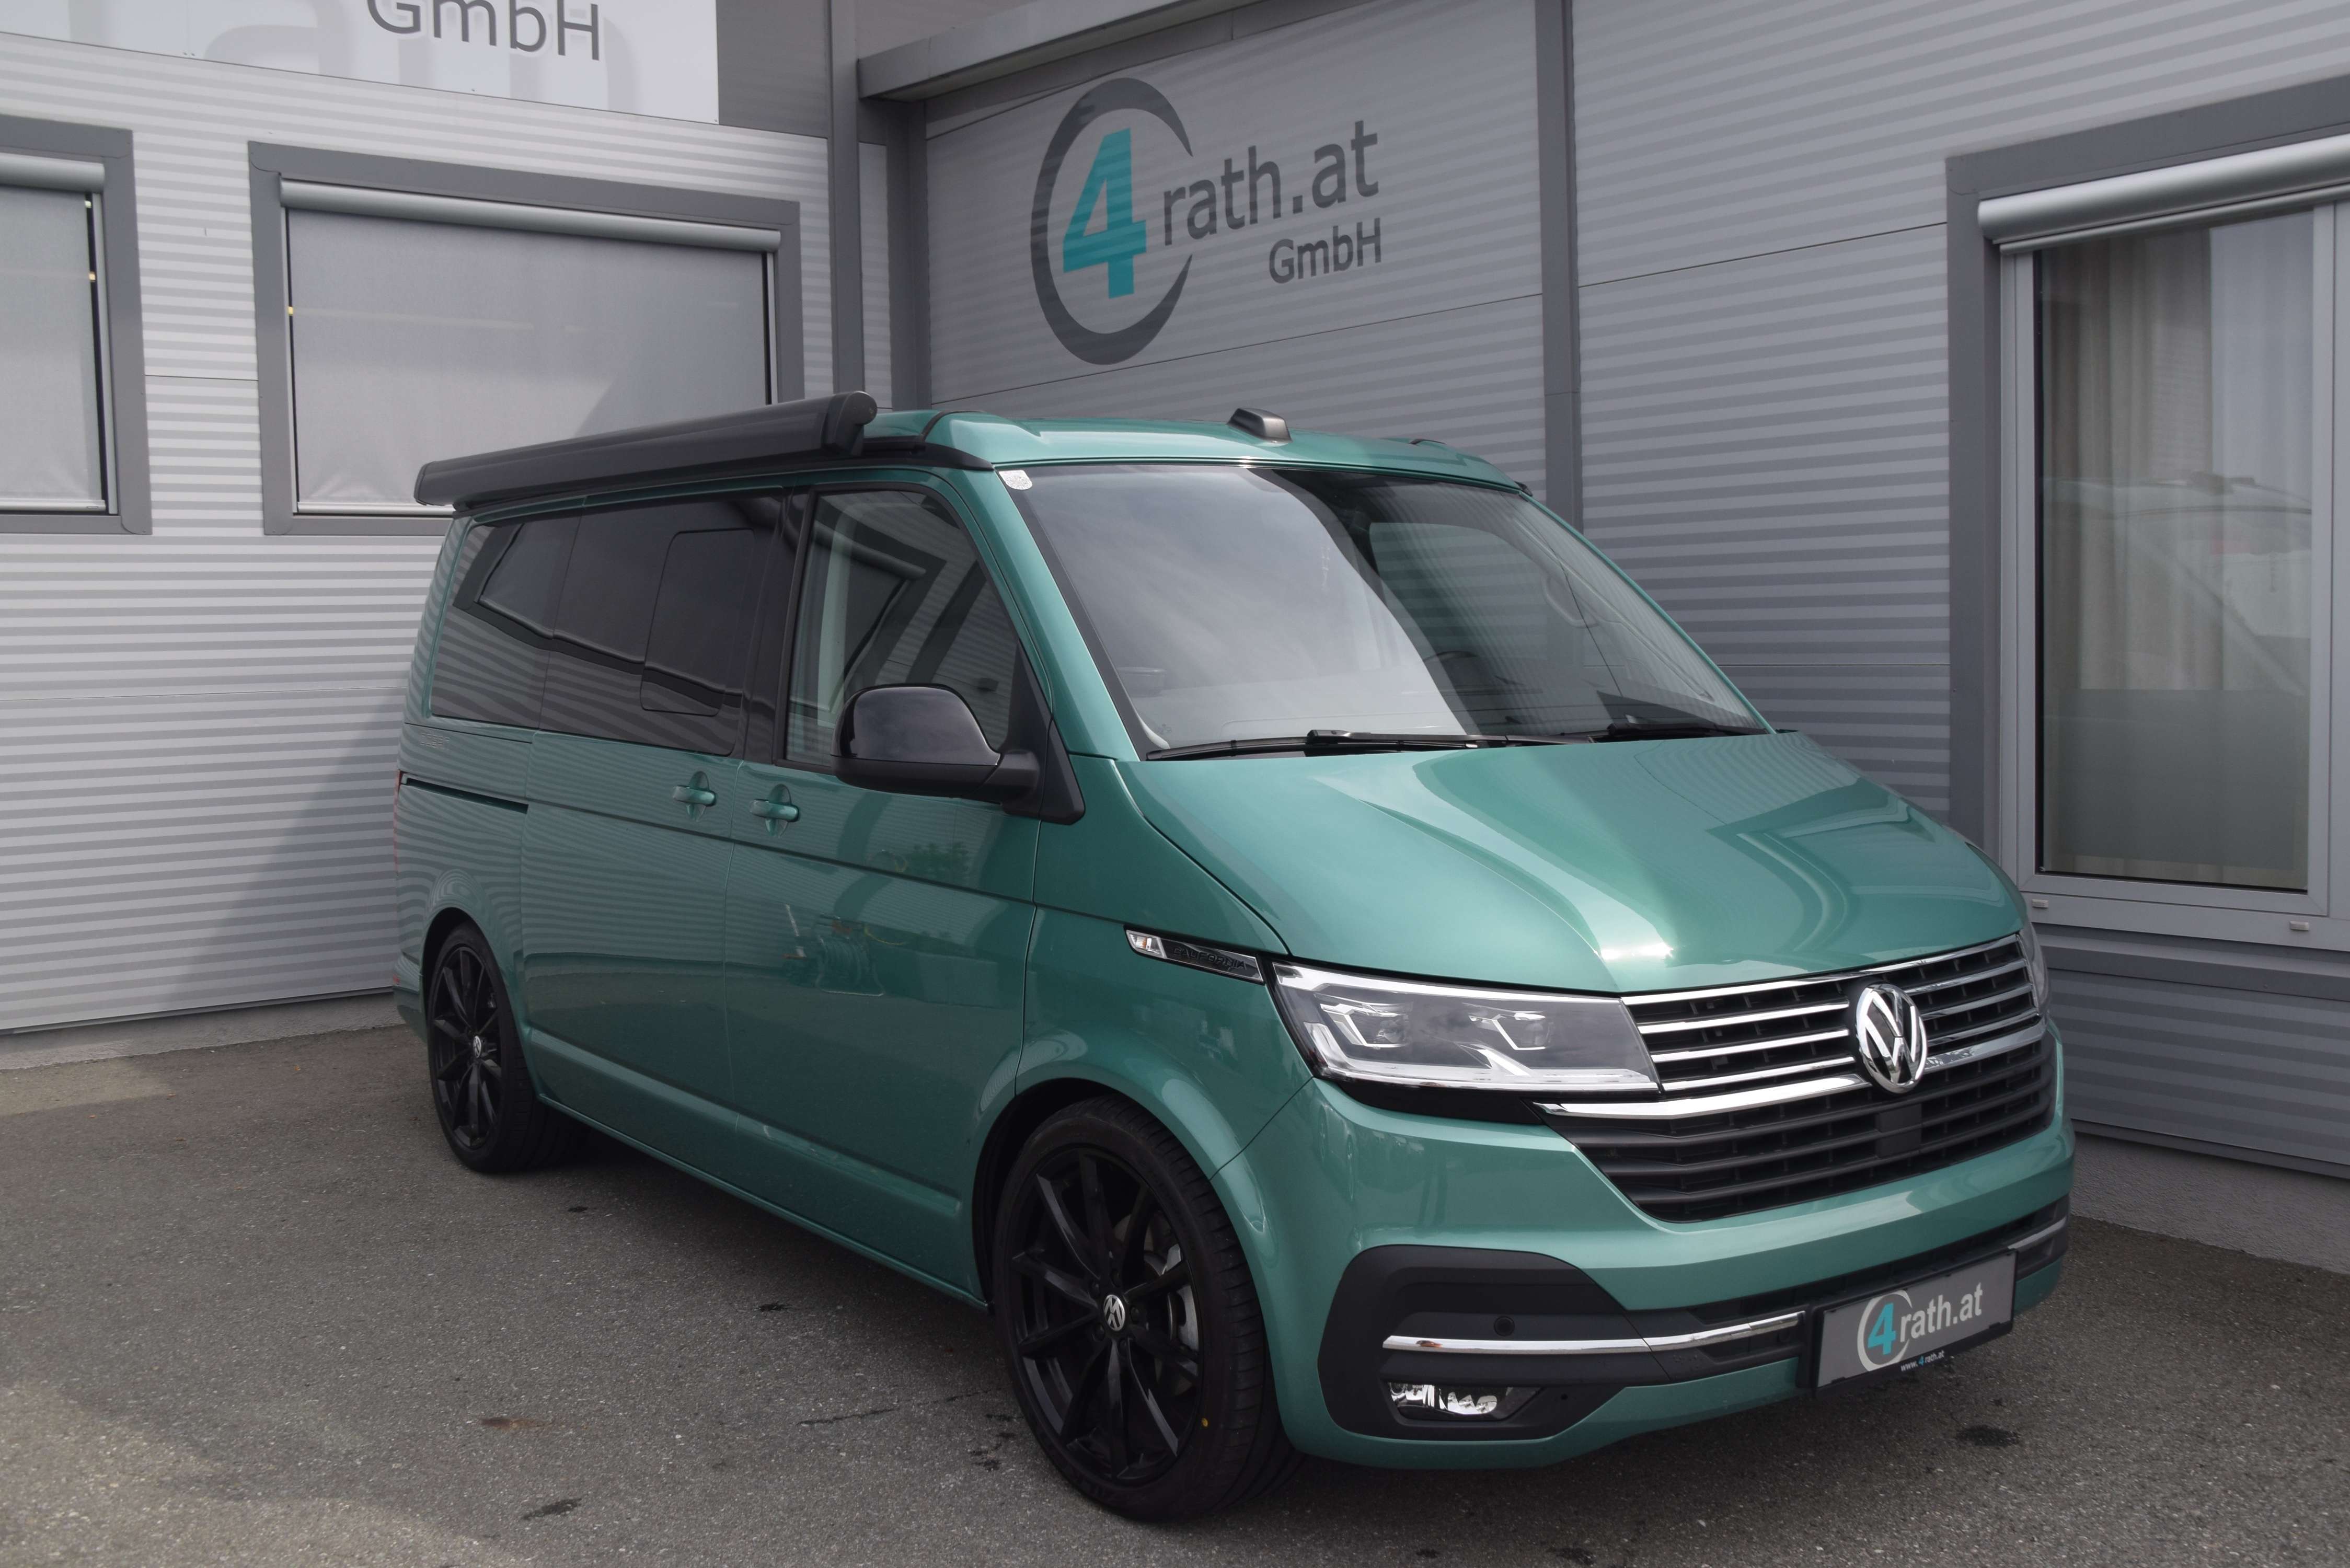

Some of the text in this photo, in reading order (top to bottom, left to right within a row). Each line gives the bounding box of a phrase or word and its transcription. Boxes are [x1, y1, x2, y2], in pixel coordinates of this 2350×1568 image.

[1063, 120, 1379, 299] 4rath.at
[1269, 217, 1381, 284] GmbH
[1173, 947, 1247, 971] CALIFORNIA
[1868, 1282, 1983, 1355] 4rath.at
